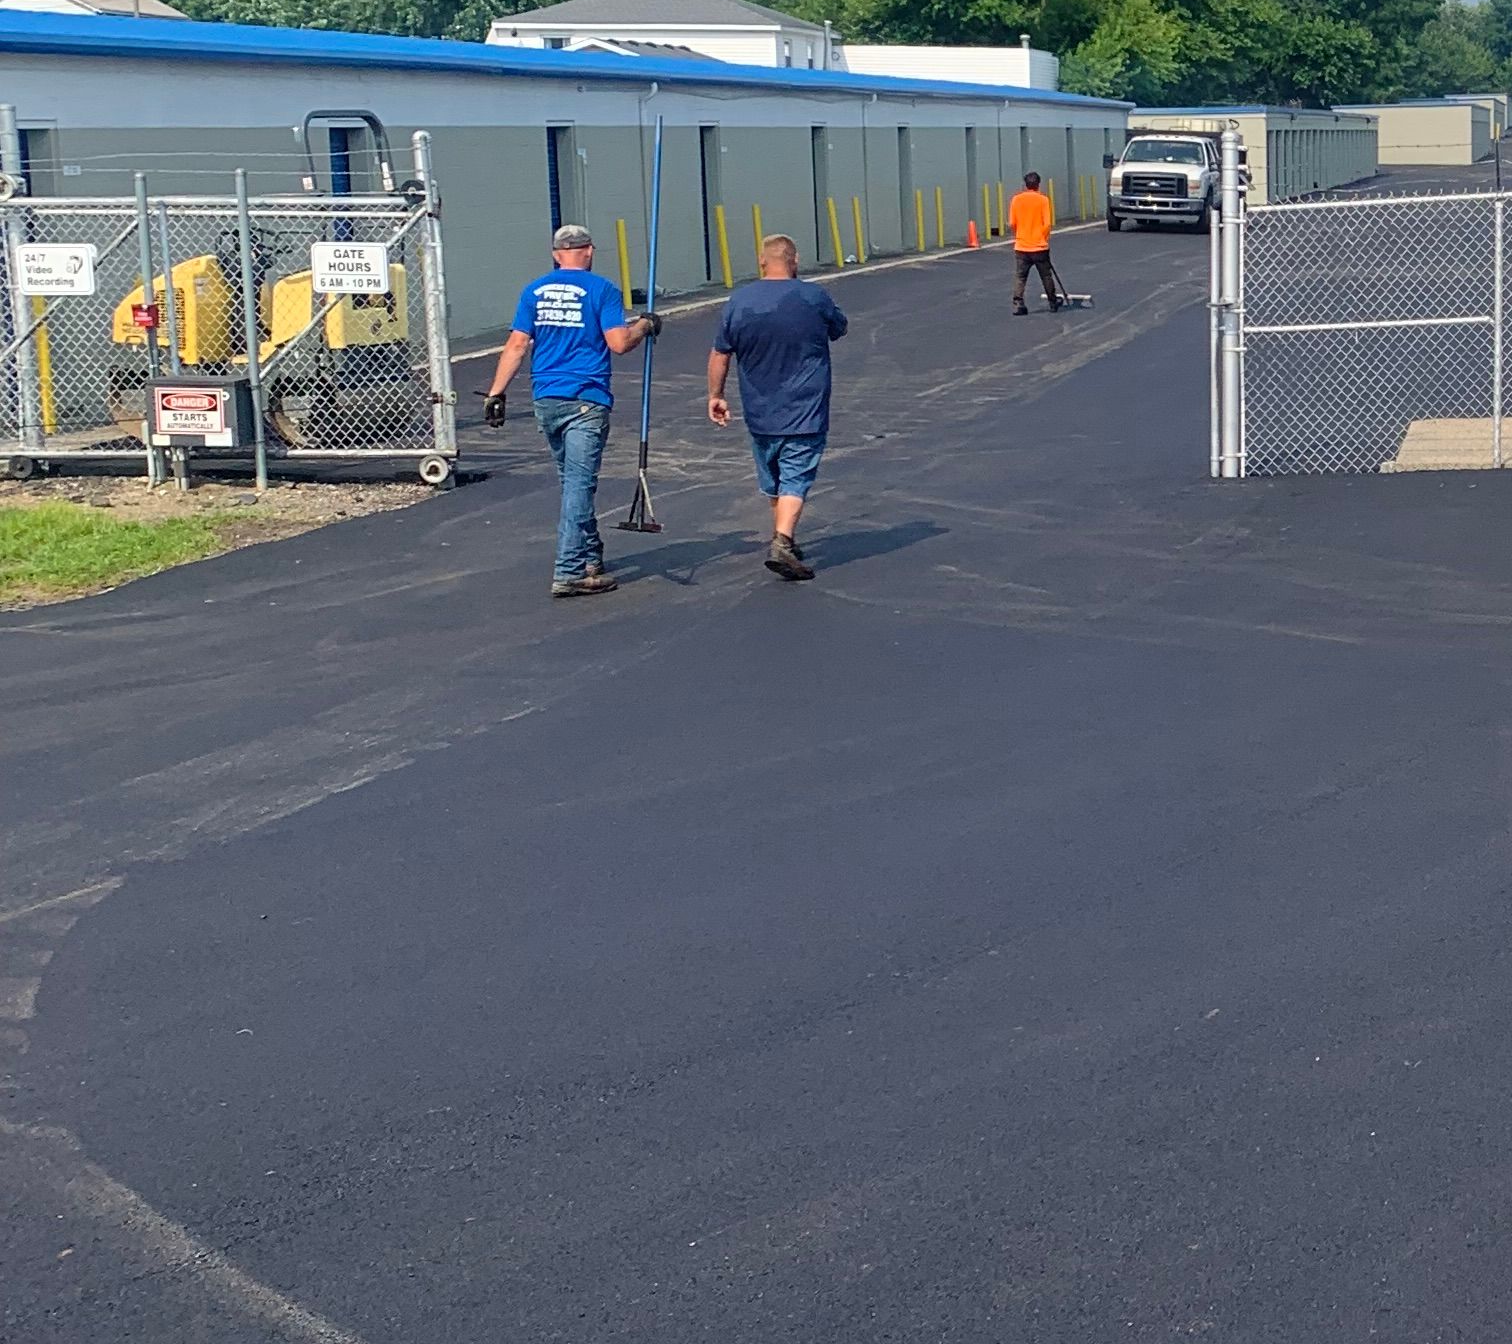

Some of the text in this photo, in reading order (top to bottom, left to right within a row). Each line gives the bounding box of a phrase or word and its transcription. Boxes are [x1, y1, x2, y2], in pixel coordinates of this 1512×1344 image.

[25, 253, 46, 262] 24/7
[333, 249, 365, 259] GATE
[25, 265, 53, 274] Video
[328, 262, 371, 272] HOURS
[27, 277, 75, 287] Recording
[320, 278, 326, 287] 6
[329, 278, 343, 287] AM
[352, 278, 364, 288] 10
[366, 278, 382, 288] PM
[170, 398, 209, 407] DANGER
[172, 413, 208, 422] STARTS
